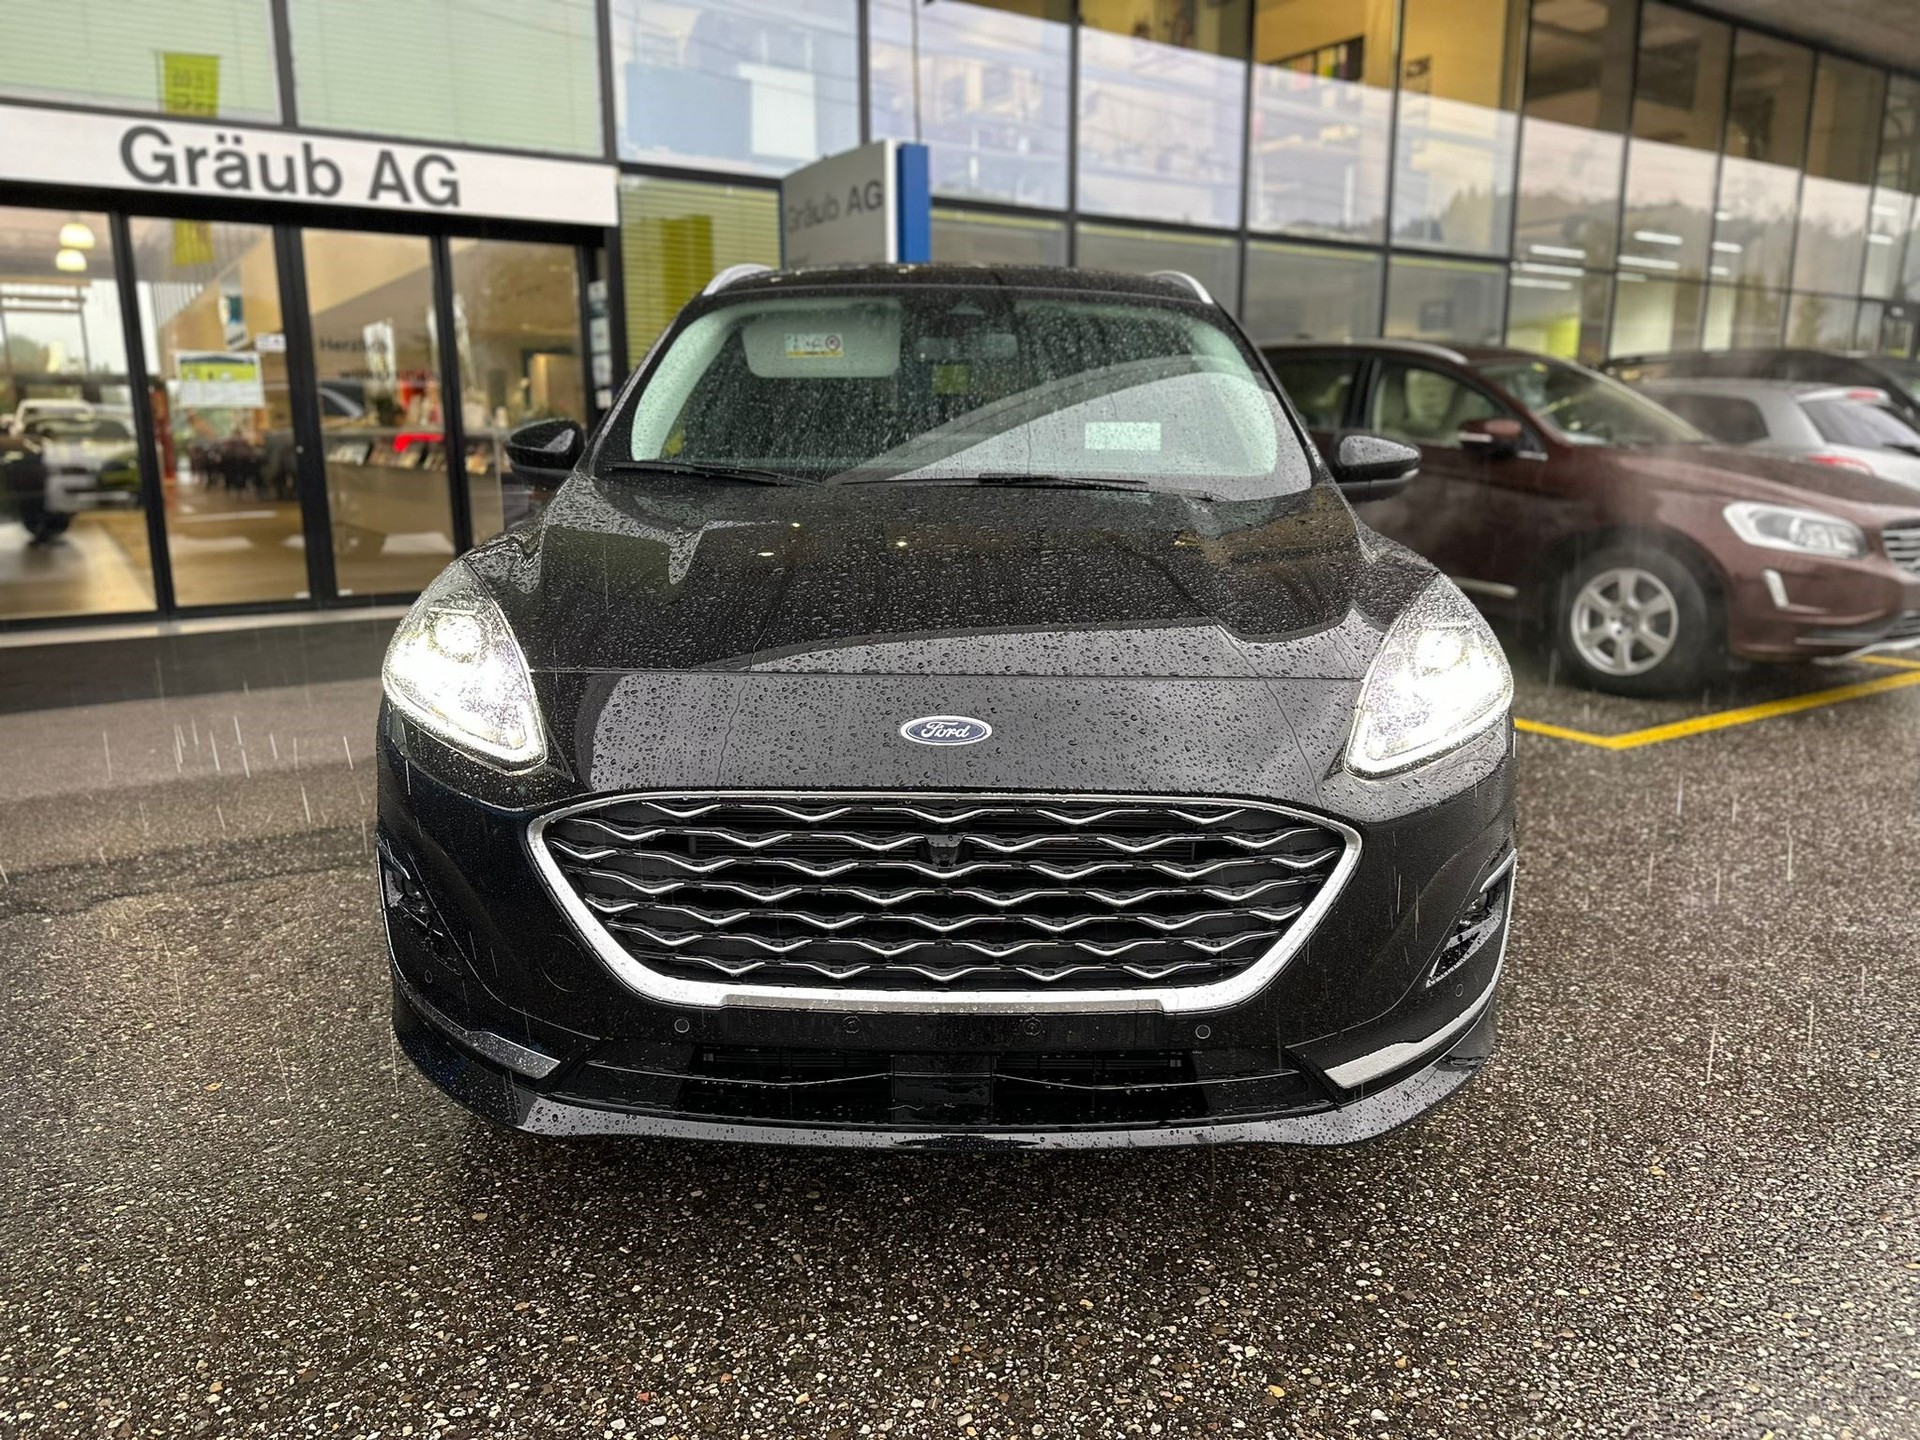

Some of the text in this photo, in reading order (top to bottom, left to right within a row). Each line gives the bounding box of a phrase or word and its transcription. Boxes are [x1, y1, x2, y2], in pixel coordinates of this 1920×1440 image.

[120, 125, 460, 208] Gräub AG
[847, 179, 884, 217] AG
[921, 721, 971, 738] Ford
